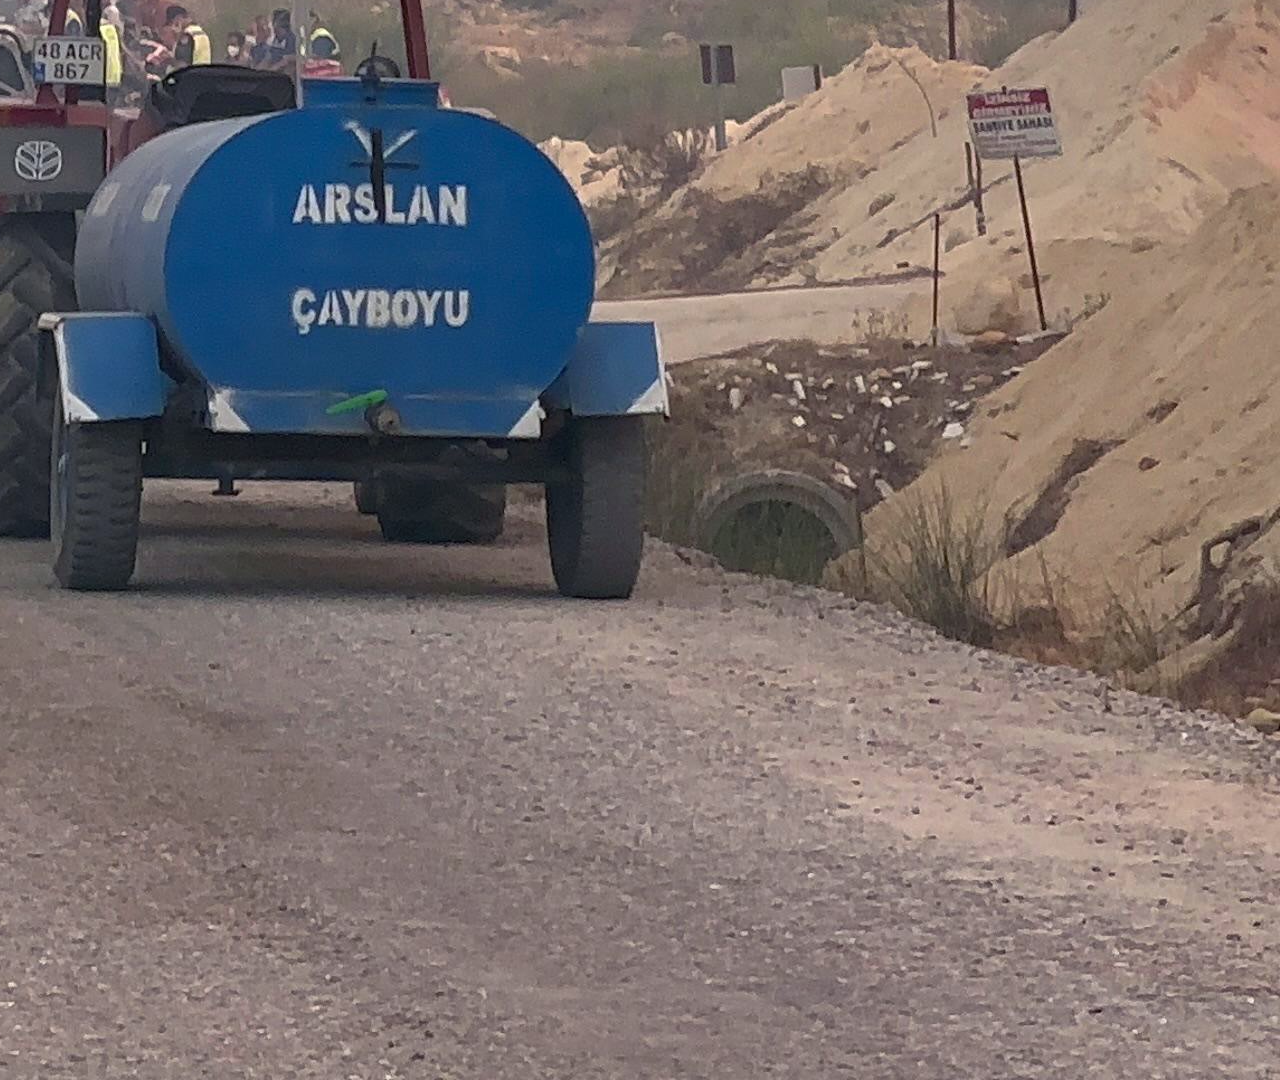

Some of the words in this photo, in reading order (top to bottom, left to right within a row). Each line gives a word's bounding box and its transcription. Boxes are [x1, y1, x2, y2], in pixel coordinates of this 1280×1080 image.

[38, 43, 61, 59] 48
[65, 43, 102, 60] ACR
[53, 62, 90, 80] 867
[292, 183, 468, 226] ARSLAN
[292, 288, 470, 335] ÇAYBOYU
